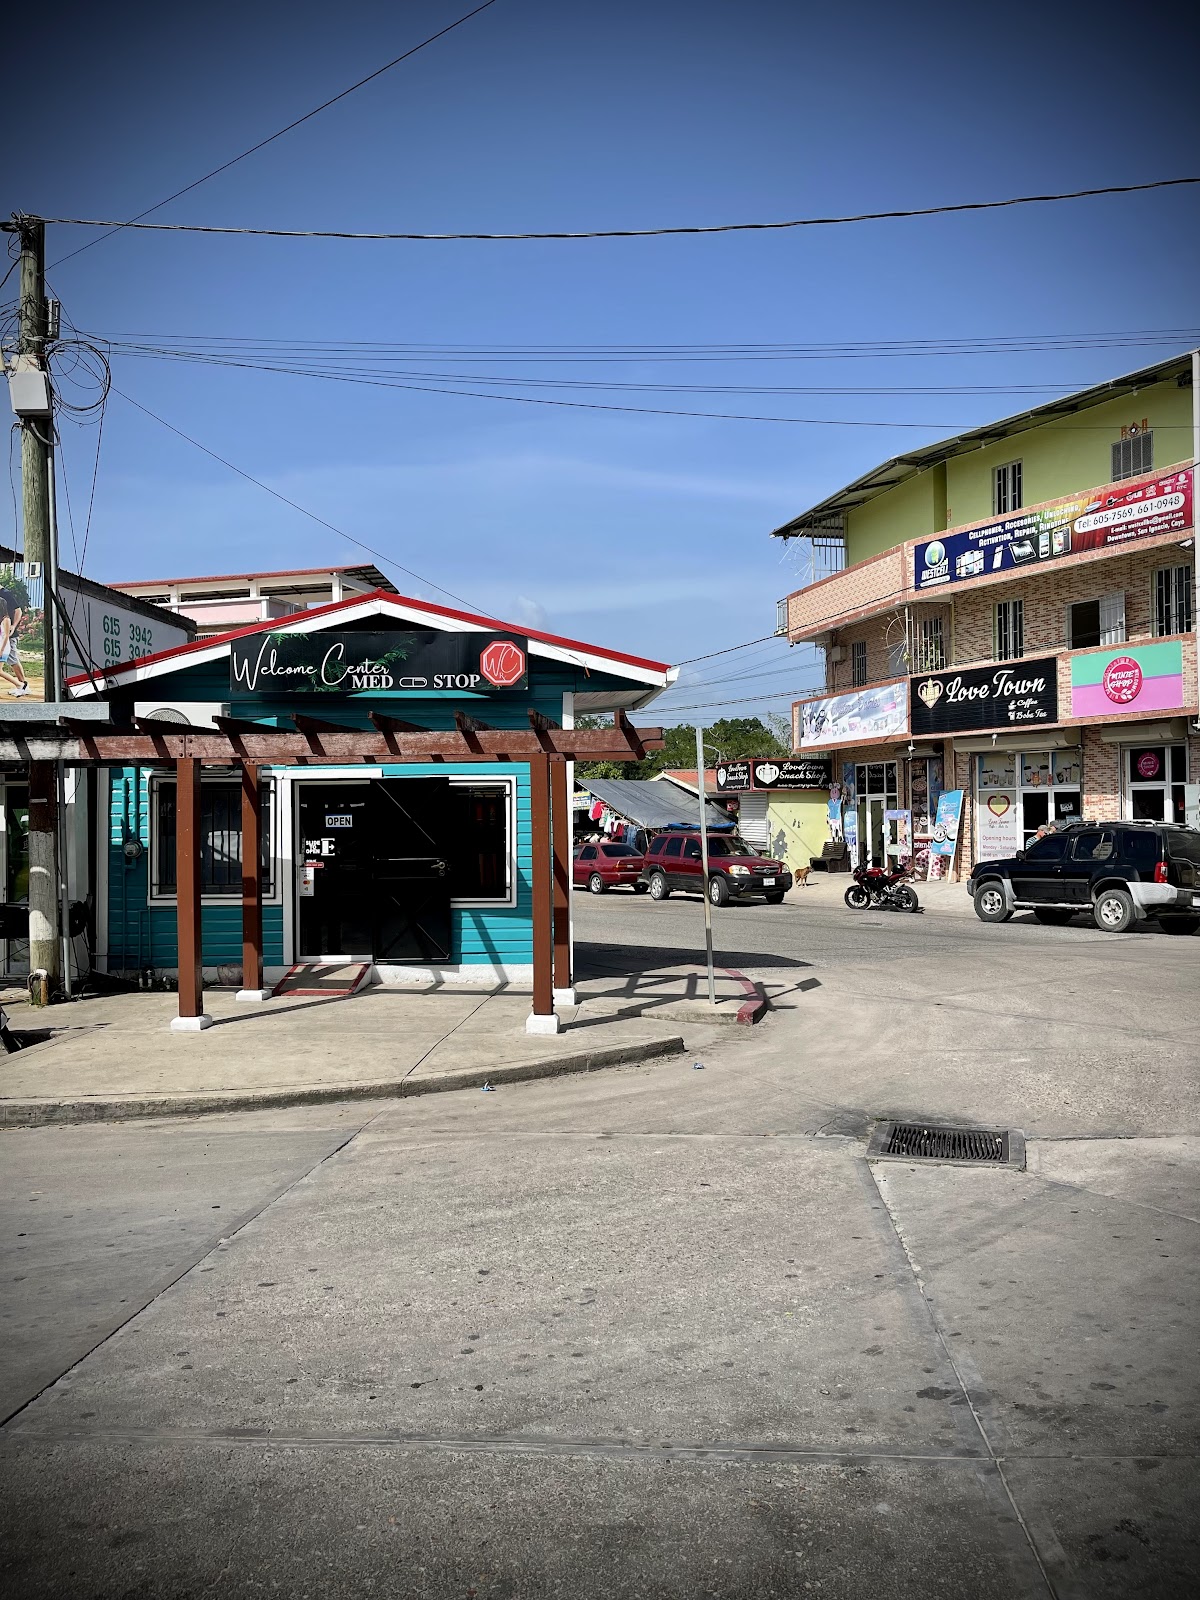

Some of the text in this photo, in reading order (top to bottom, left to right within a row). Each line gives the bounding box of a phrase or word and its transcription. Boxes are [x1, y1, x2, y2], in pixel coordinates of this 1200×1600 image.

[1077, 496, 1180, 531] Tel: 605-7569, 661-0948
[1107, 531, 1137, 542] Downtown,
[1149, 522, 1170, 533] Ignacio,
[103, 615, 153, 646] 615 3942
[103, 637, 121, 658] 615
[233, 635, 389, 690] Welcome Center
[352, 674, 481, 689] MED STOP
[946, 670, 1047, 703] Love Town
[1016, 698, 1039, 708] Coffee
[1015, 708, 1048, 720] Boba Tea
[779, 770, 827, 784] Snack Shop
[327, 817, 352, 826] OPEN
